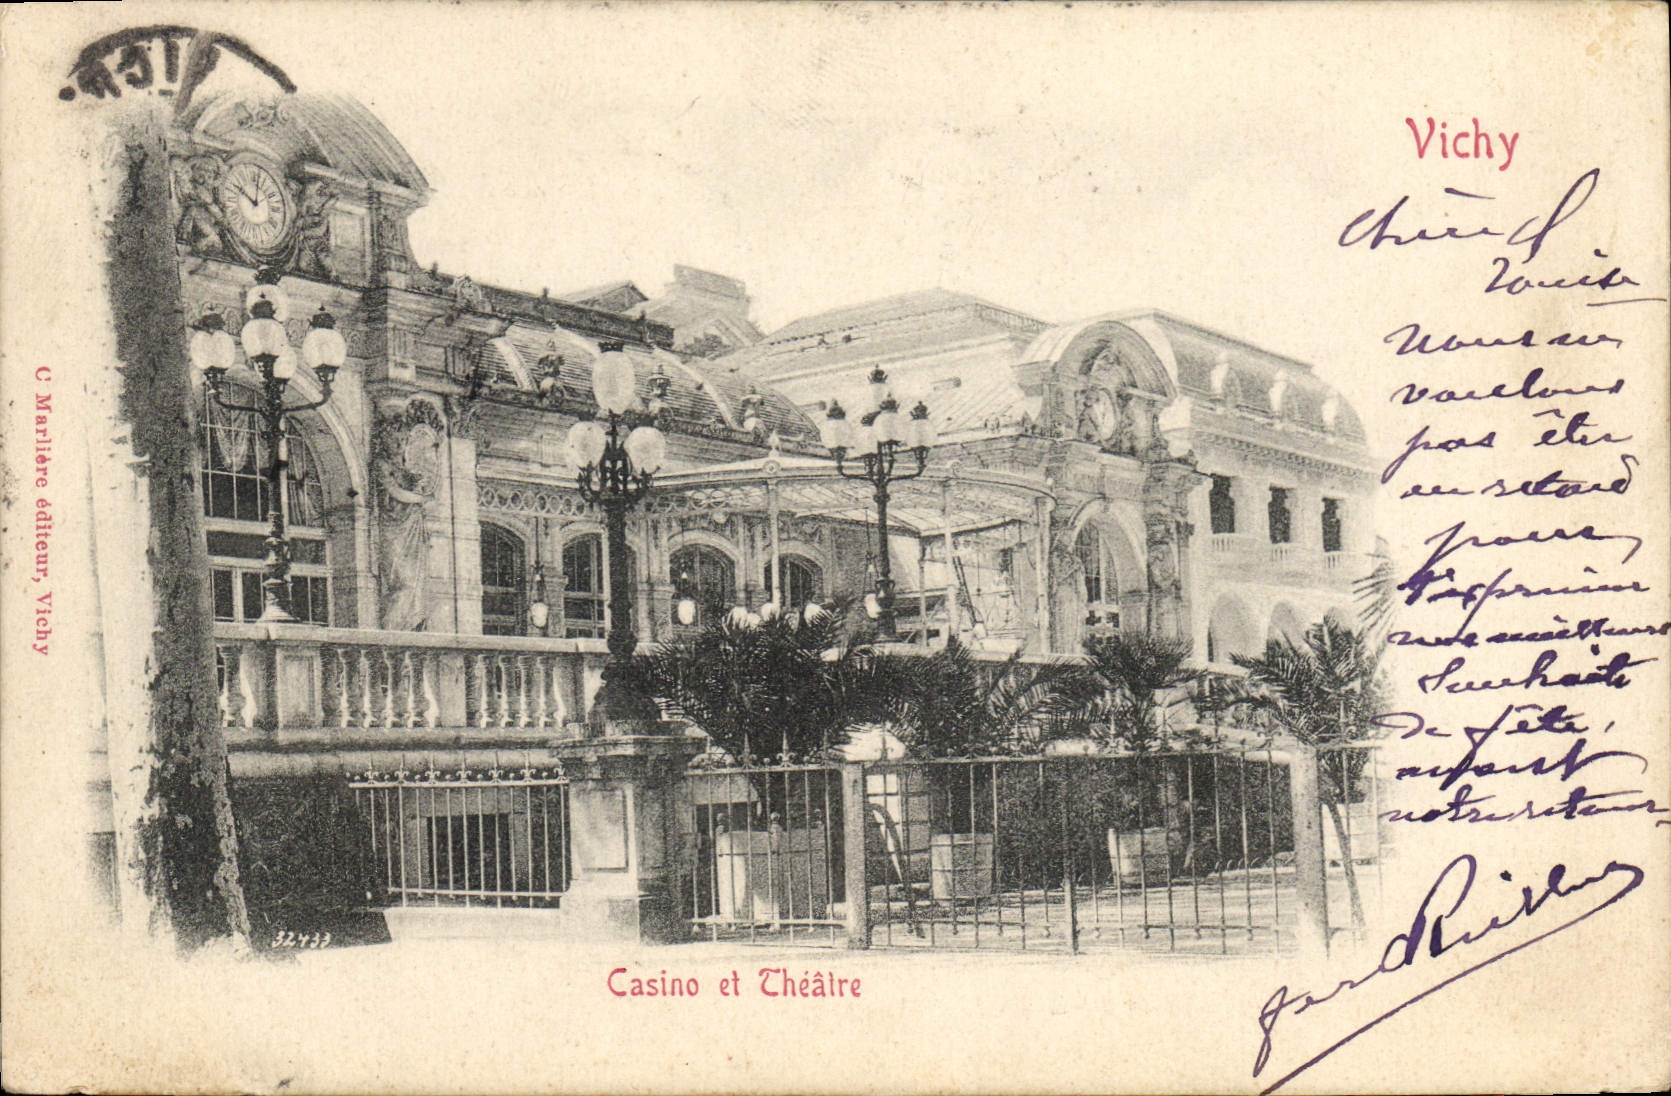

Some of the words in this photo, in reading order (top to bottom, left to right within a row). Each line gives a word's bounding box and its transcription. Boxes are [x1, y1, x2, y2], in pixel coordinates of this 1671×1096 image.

[1405, 117, 1519, 171] Vichy
[34, 366, 52, 382] C
[34, 393, 52, 488] Marlière
[1381, 425, 1496, 484] pas
[31, 497, 52, 583] éditeur,
[32, 591, 52, 656] Vichy
[607, 967, 699, 997] Casino
[719, 970, 740, 996] et
[758, 967, 862, 998] Théâtre
